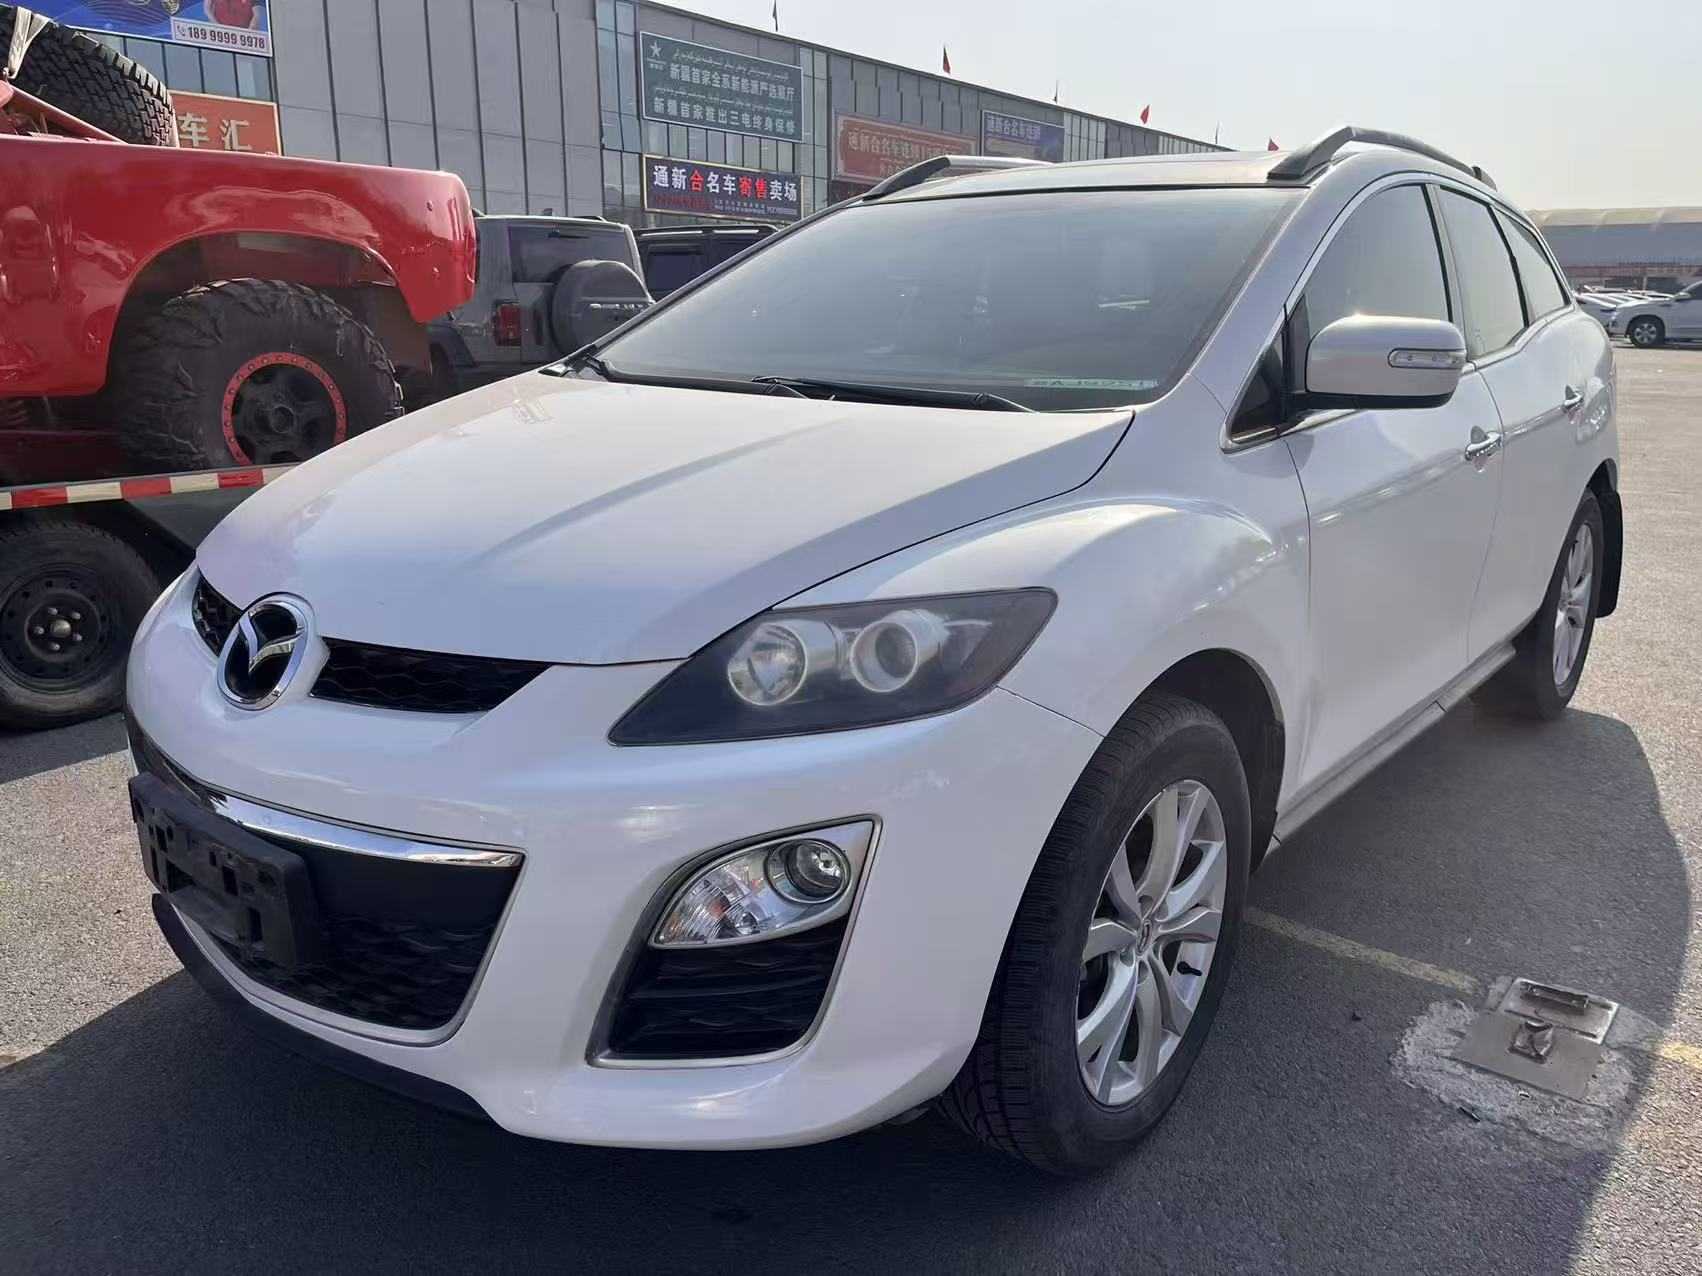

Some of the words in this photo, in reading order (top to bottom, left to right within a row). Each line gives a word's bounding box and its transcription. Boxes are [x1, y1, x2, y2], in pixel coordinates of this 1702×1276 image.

[188, 26, 207, 40] 189
[209, 30, 238, 45] 9999
[177, 112, 253, 151] 车汇
[653, 165, 797, 202] 通新合名车寄售卖场
